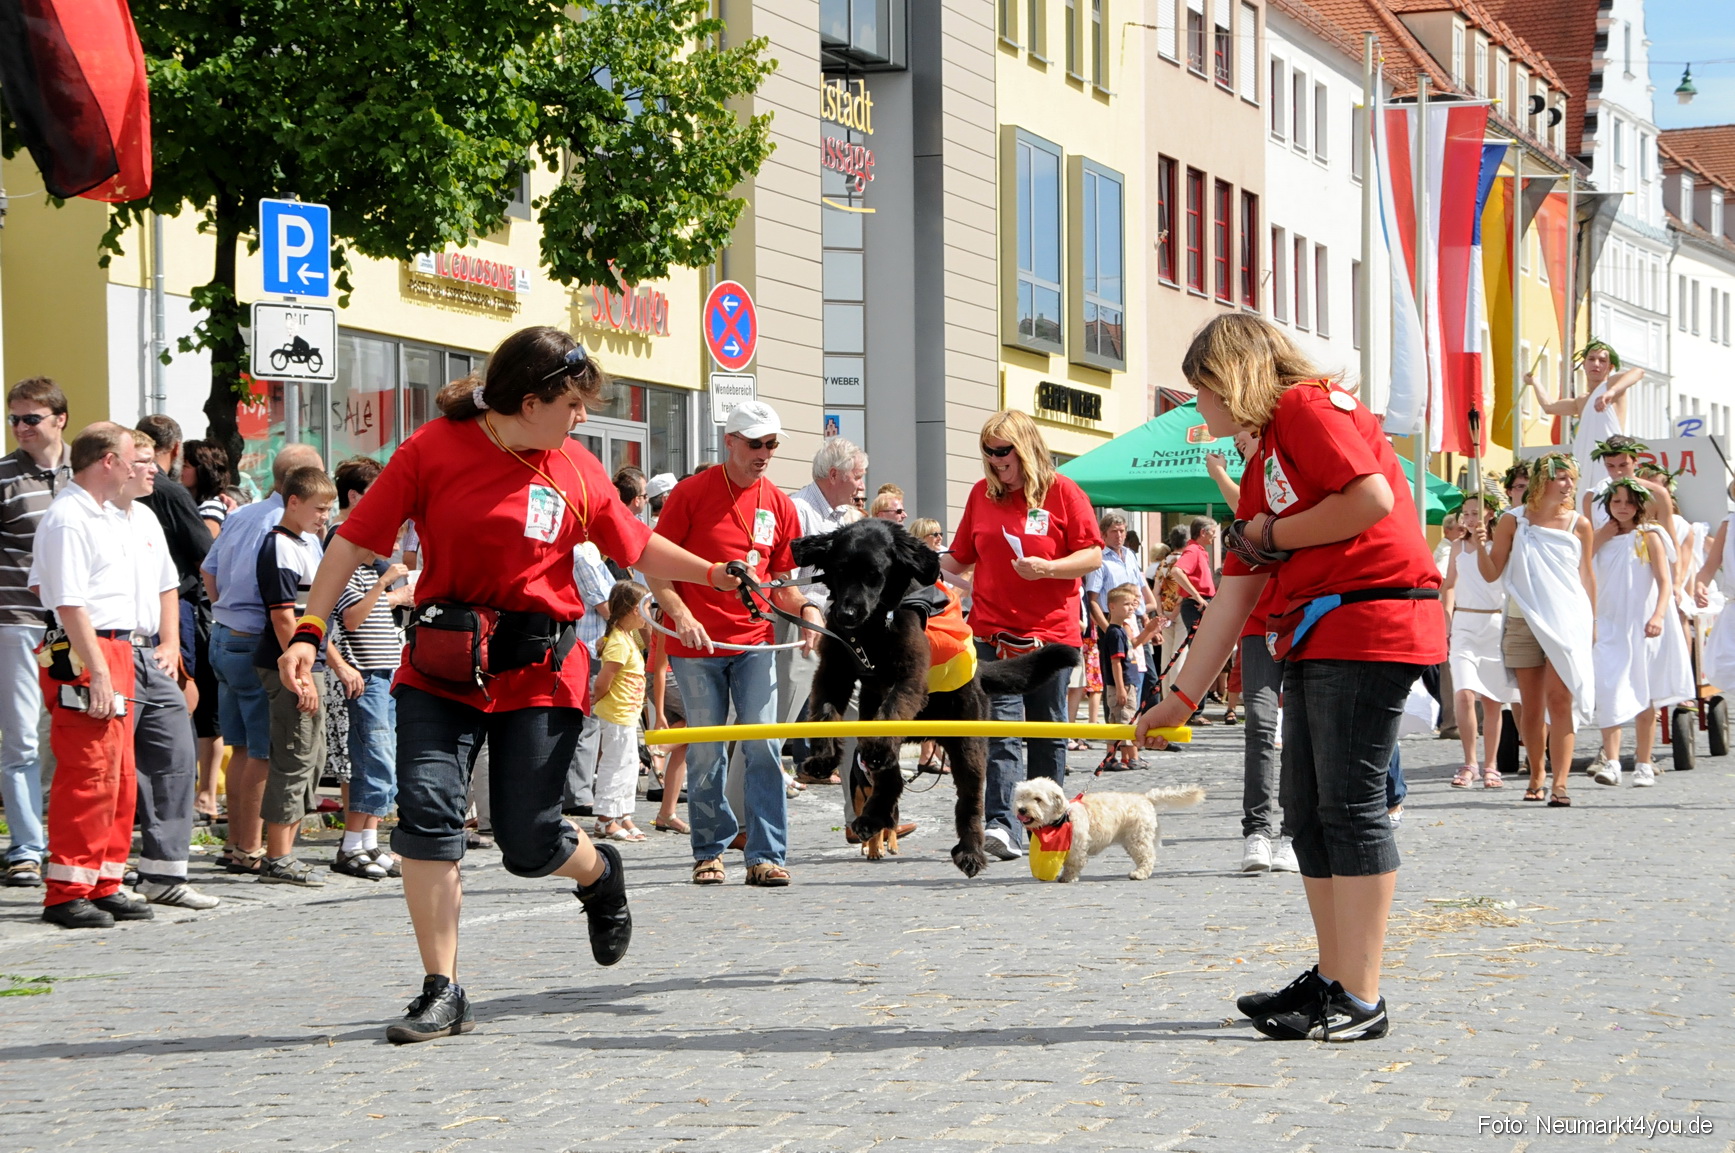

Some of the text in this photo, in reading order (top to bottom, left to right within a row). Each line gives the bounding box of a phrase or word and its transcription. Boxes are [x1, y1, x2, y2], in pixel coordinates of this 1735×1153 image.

[277, 213, 314, 283] P
[436, 251, 516, 291] IL GOLOSONE
[831, 377, 860, 386] WEBER
[715, 383, 752, 396] Wendebereich
[1152, 447, 1239, 458] Neumarkte
